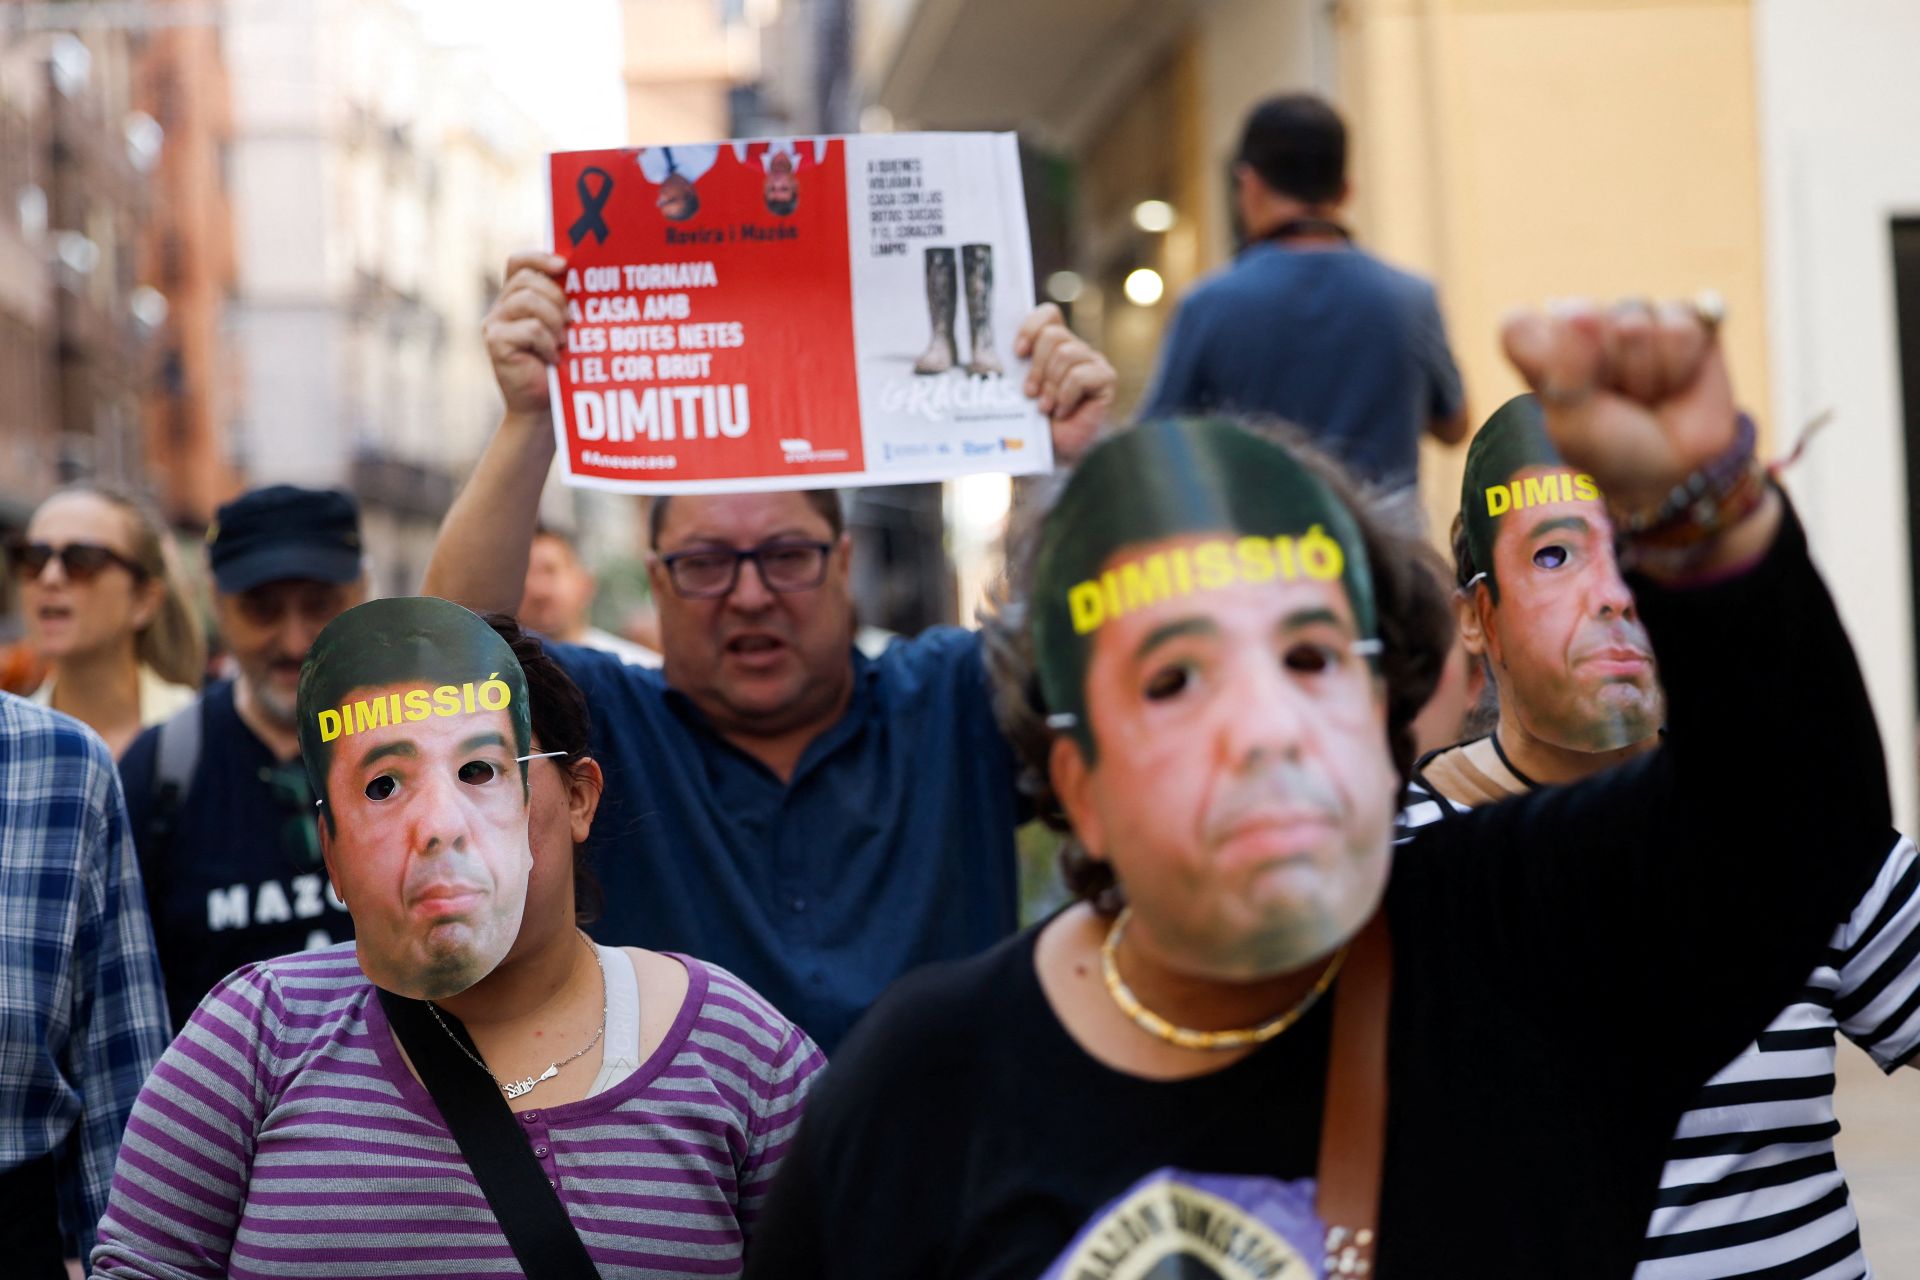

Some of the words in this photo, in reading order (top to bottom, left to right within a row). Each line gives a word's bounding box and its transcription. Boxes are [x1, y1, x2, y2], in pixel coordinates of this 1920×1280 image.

[665, 225, 724, 245] Rovira
[565, 267, 581, 293] A
[584, 265, 620, 293] QUI
[622, 261, 718, 290] TORNAVA
[569, 297, 582, 323] A
[585, 296, 640, 322] CASA
[643, 294, 691, 320] AMB
[568, 328, 607, 353] LES
[610, 325, 676, 350] BOTES
[678, 322, 744, 348] NETES
[570, 359, 580, 384] I
[582, 357, 608, 383] EL
[611, 356, 654, 382] COR
[657, 353, 712, 379] BRUT
[572, 384, 750, 442] DIMITIU
[1067, 524, 1344, 635] DIMISSIÓ
[318, 672, 511, 742] DIMISSIÓ
